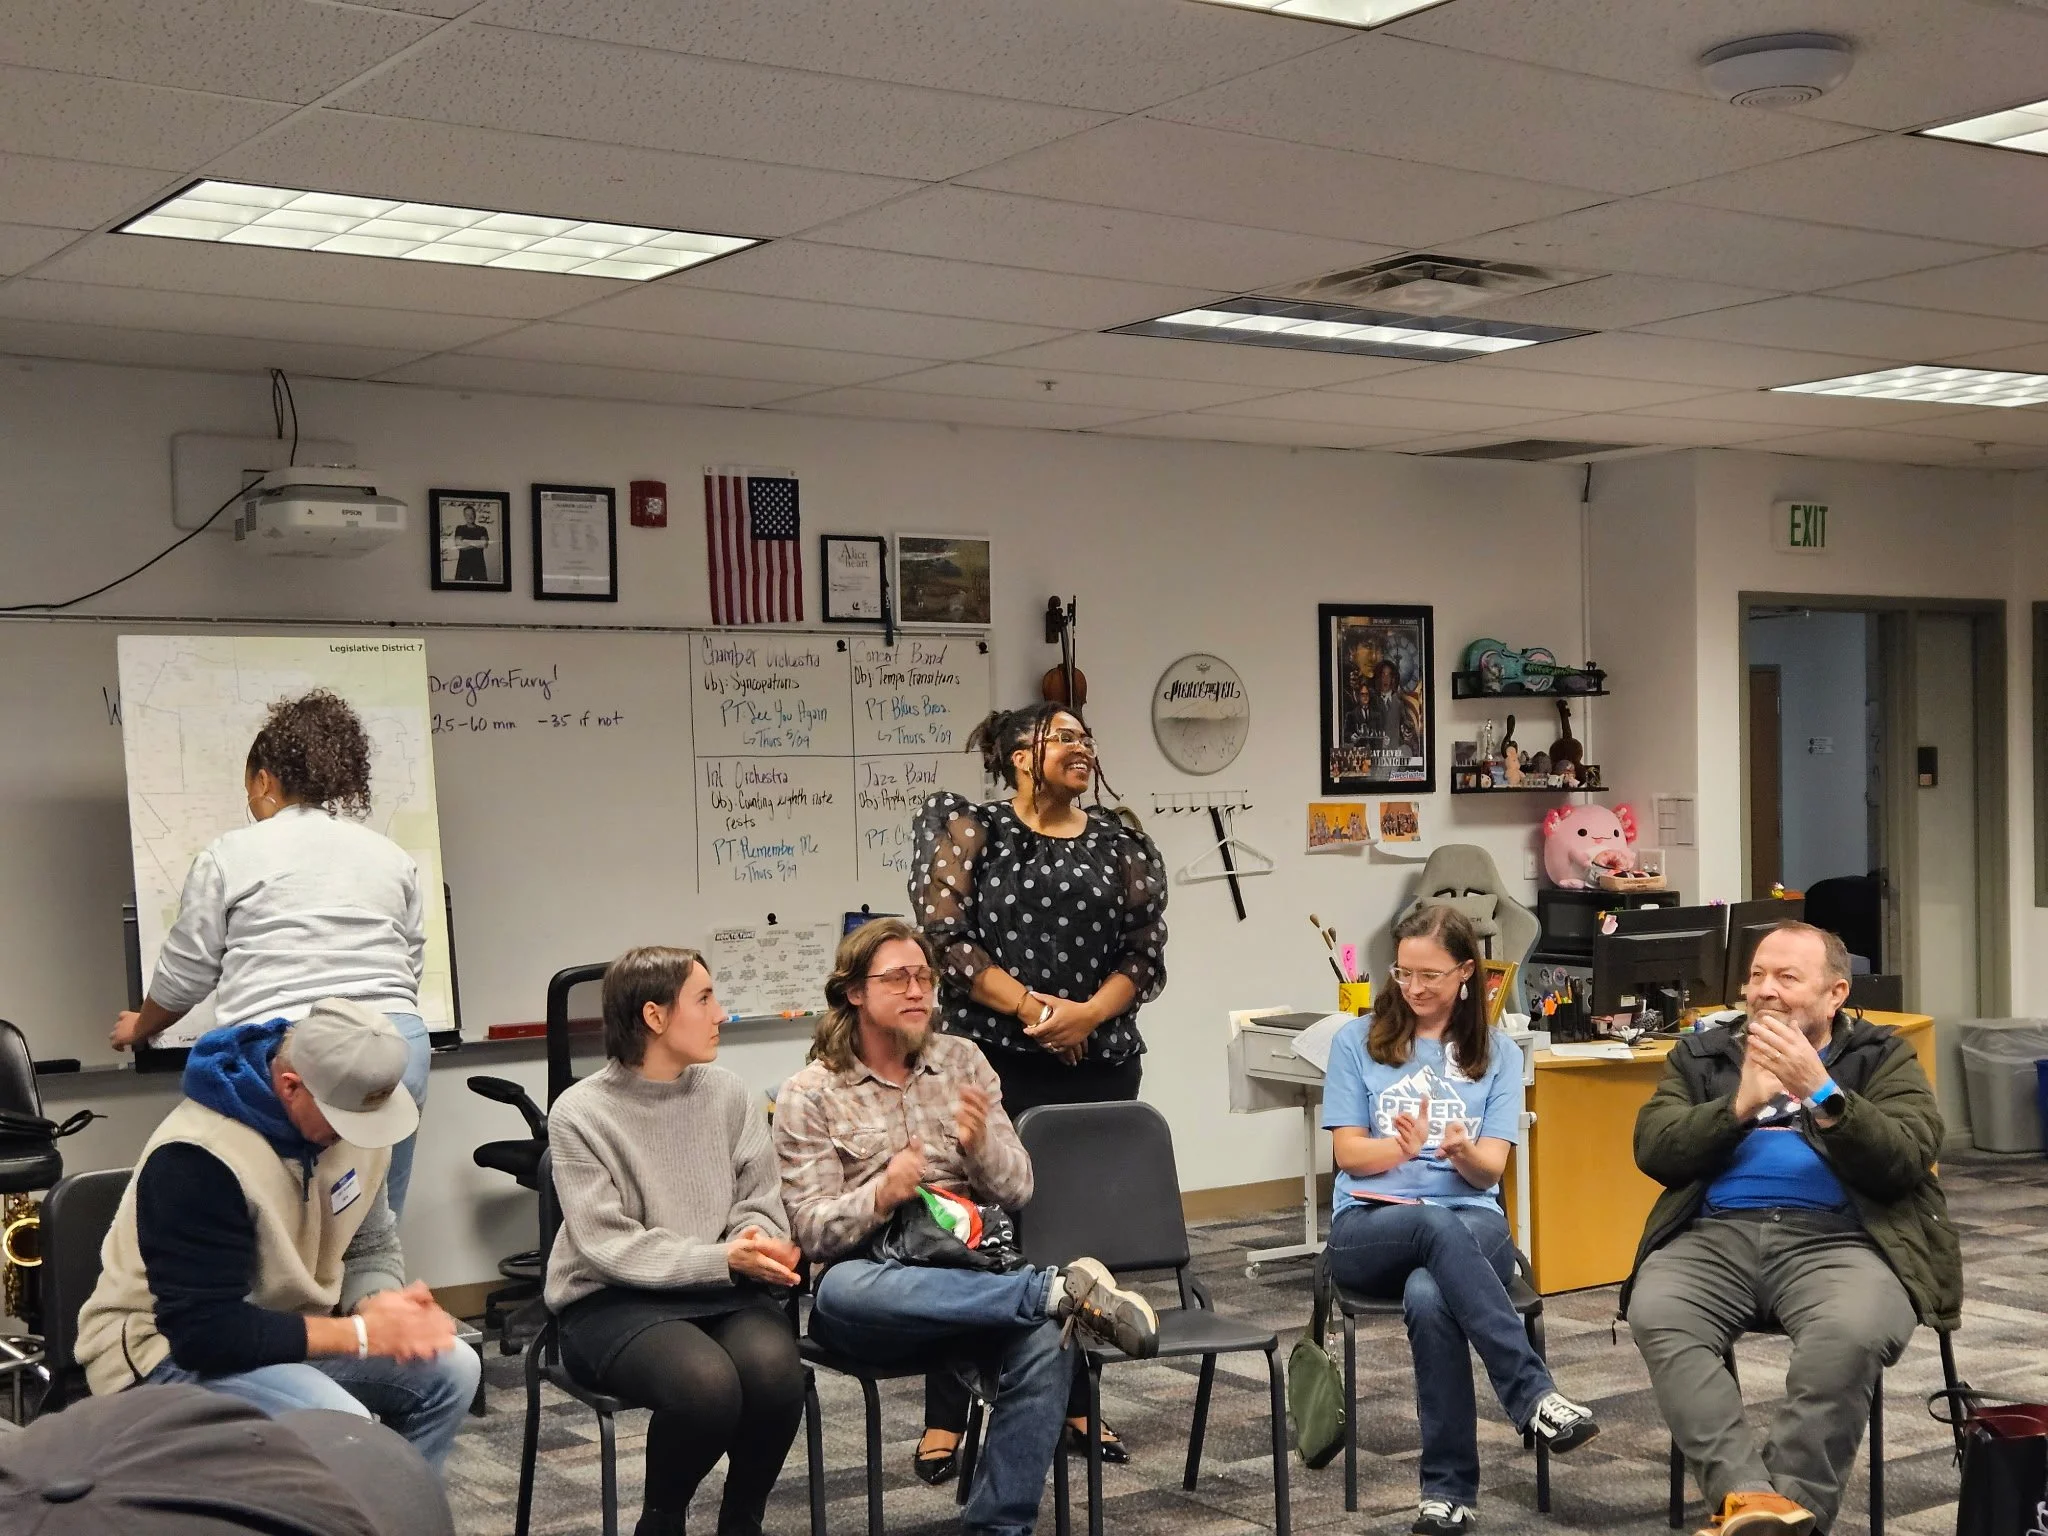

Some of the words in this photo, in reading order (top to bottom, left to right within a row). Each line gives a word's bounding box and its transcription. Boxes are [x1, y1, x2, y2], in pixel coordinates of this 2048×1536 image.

[1791, 505, 1828, 547] EXIT
[841, 543, 867, 559] Alice
[330, 644, 380, 654] Legislative
[382, 644, 415, 652] District
[417, 644, 423, 652] 7
[702, 636, 756, 668] Chamber
[767, 647, 820, 668] Orchestra
[854, 640, 900, 664] Concert
[911, 642, 948, 665] Band
[730, 671, 800, 697] Syncopations
[876, 664, 905, 690] Tempo
[907, 668, 960, 687] Transitions
[579, 710, 590, 727] if
[598, 710, 624, 727] not
[747, 702, 772, 724] See
[775, 700, 793, 728] You
[798, 700, 827, 730] Again
[891, 695, 919, 720] Blues
[755, 728, 782, 748] Thurs
[786, 729, 810, 749] 5/09
[893, 725, 926, 744] Thurs
[929, 723, 952, 745] 5/09
[735, 761, 789, 789] Orchestra
[860, 761, 897, 788] Jazz
[904, 760, 938, 785] Band
[738, 790, 774, 821] Counting
[812, 790, 833, 806] note
[726, 813, 756, 831] rests
[740, 835, 795, 860] Remember
[800, 834, 819, 856] Me
[745, 861, 773, 883] Thurs
